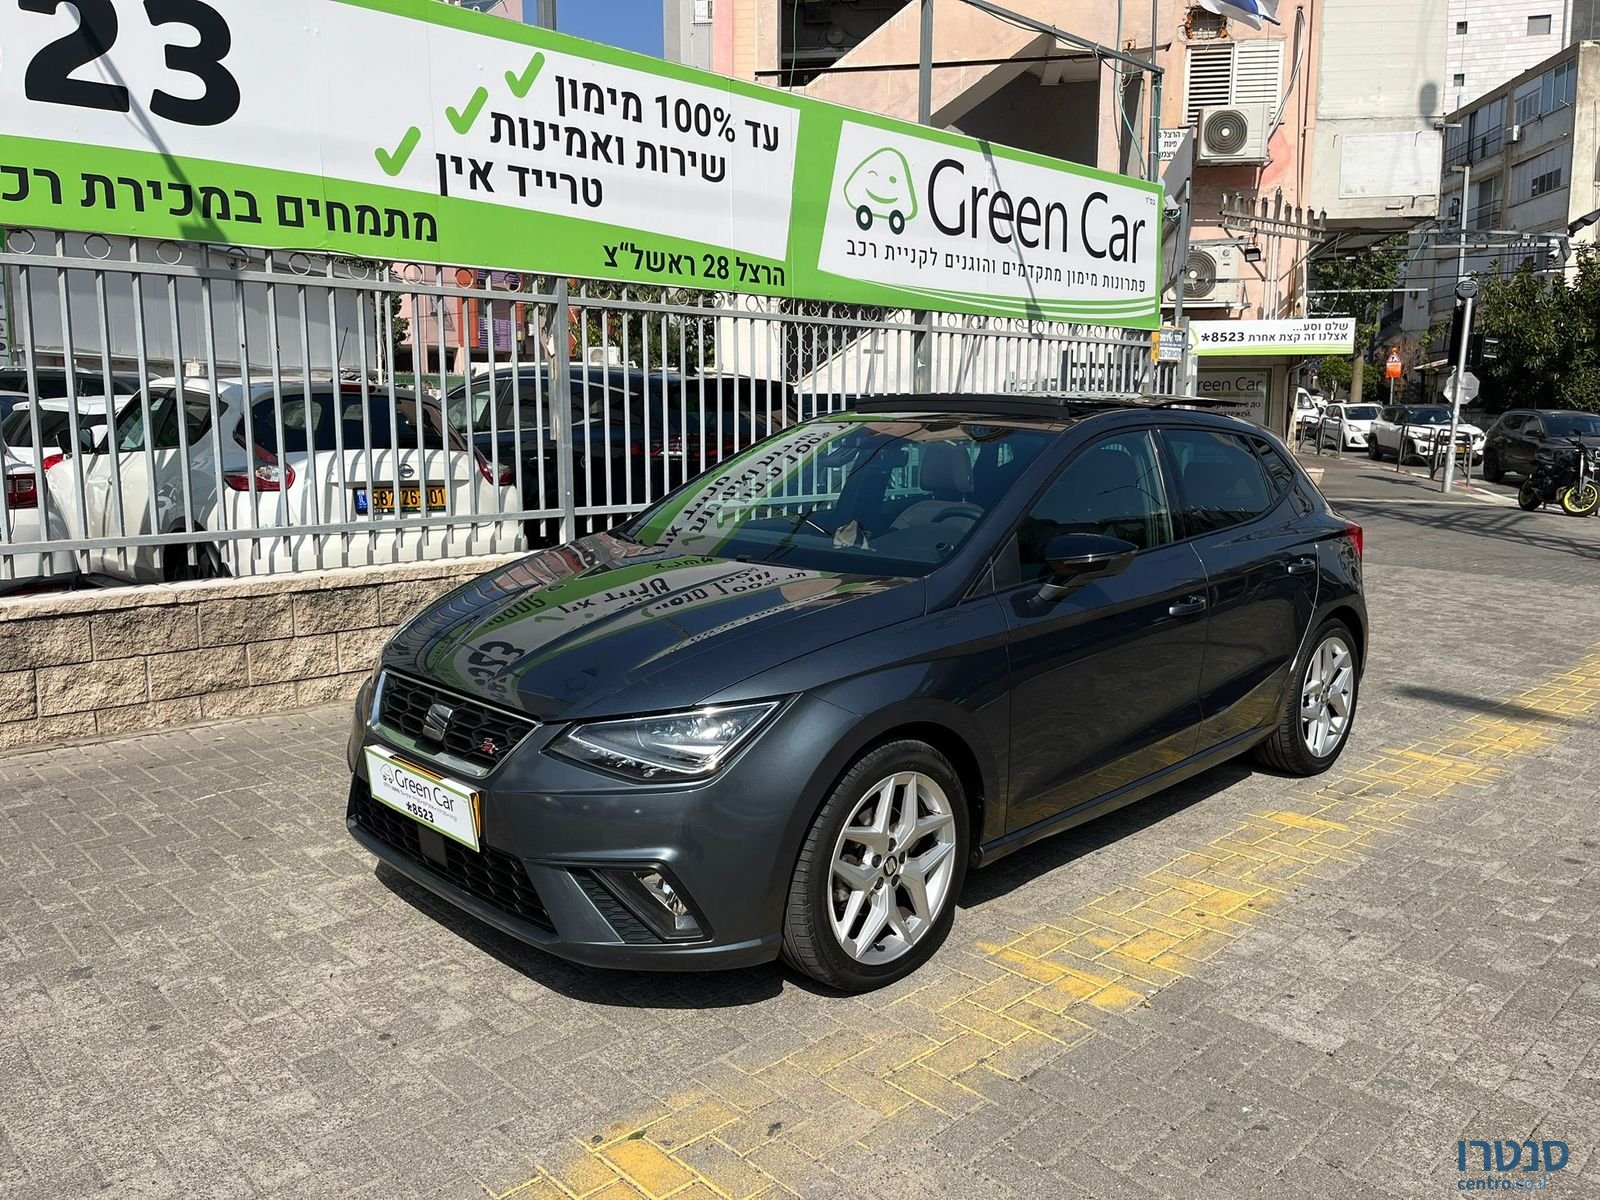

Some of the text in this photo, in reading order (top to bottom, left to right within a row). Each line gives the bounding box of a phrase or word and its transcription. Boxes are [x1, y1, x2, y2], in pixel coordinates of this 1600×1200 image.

[555, 75, 779, 152] עד 100% מימון
[490, 111, 726, 183] שירות ואמינות
[80, 172, 262, 224] במכירת
[435, 153, 603, 208] טרייד אין
[277, 196, 438, 243] מתמחים
[927, 158, 1146, 264] Green Car
[702, 253, 730, 280] 28
[736, 256, 785, 287] הרצל
[846, 239, 1145, 293] פתרונות מימון מתקדמים והוגנים לקניית רכב
[1248, 334, 1276, 342] אחרת
[1279, 333, 1301, 344] קצת
[1304, 333, 1316, 341] זה
[1319, 332, 1348, 341] אצלנו
[1324, 322, 1349, 331] שלם
[1198, 376, 1263, 392] reen Car
[395, 769, 431, 801] Green
[433, 787, 454, 812] Car
